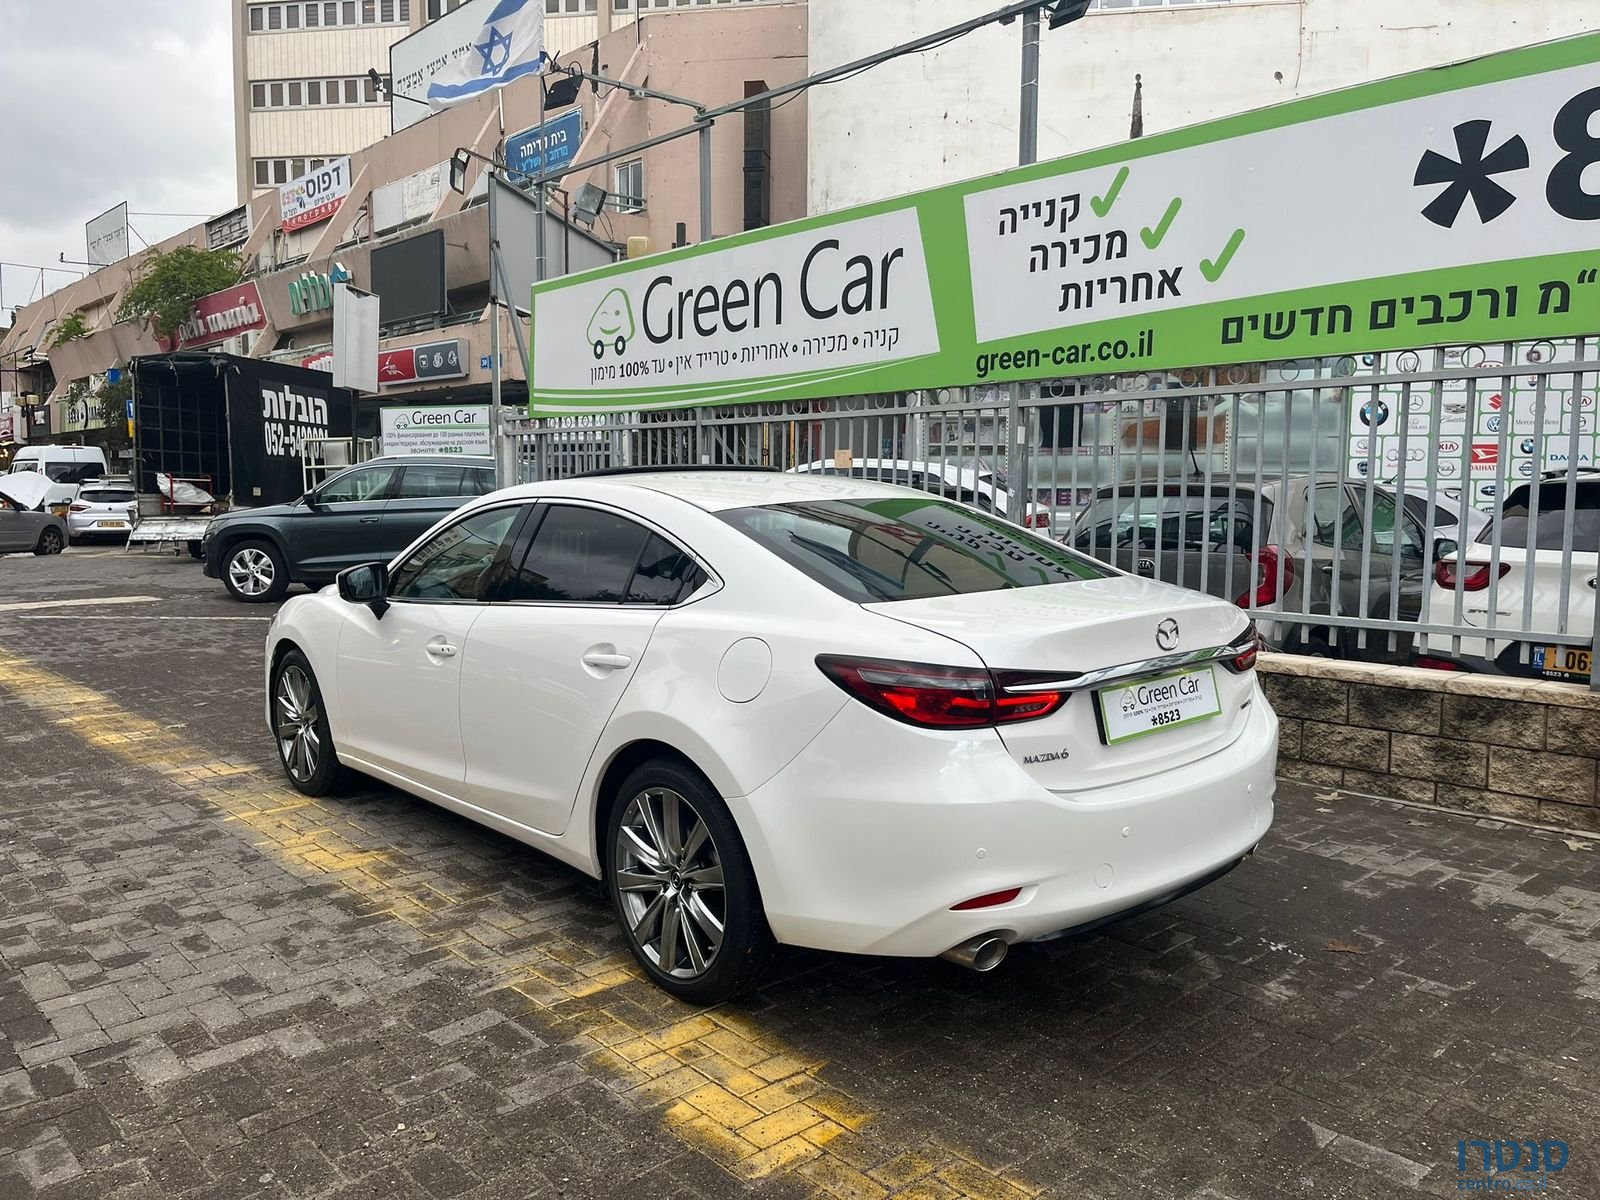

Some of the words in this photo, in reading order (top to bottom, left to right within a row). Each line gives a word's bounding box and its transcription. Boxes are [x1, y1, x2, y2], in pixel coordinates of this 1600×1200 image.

[550, 129, 568, 147] בית
[305, 164, 342, 199] דפוס
[999, 194, 1081, 236] קנייה
[1029, 228, 1128, 273] מכירה
[643, 272, 782, 344] Green
[800, 239, 904, 320] Car
[1058, 266, 1183, 312] אחריות
[1369, 285, 1518, 330] ורכבים
[1221, 304, 1352, 346] חדשים
[740, 341, 789, 364] אחריות
[803, 334, 848, 356] מכירה
[863, 327, 899, 352] קניה
[651, 357, 665, 373] עד
[675, 354, 692, 376] אין
[695, 349, 729, 368] טרייד
[976, 329, 1154, 379] green-car.co.il
[590, 365, 616, 386] מימון
[619, 360, 650, 378] 100%
[262, 385, 328, 426] הובלות
[411, 410, 451, 425] Green
[454, 409, 477, 424] Car
[1137, 682, 1178, 707] Green
[1178, 676, 1200, 697] Car
